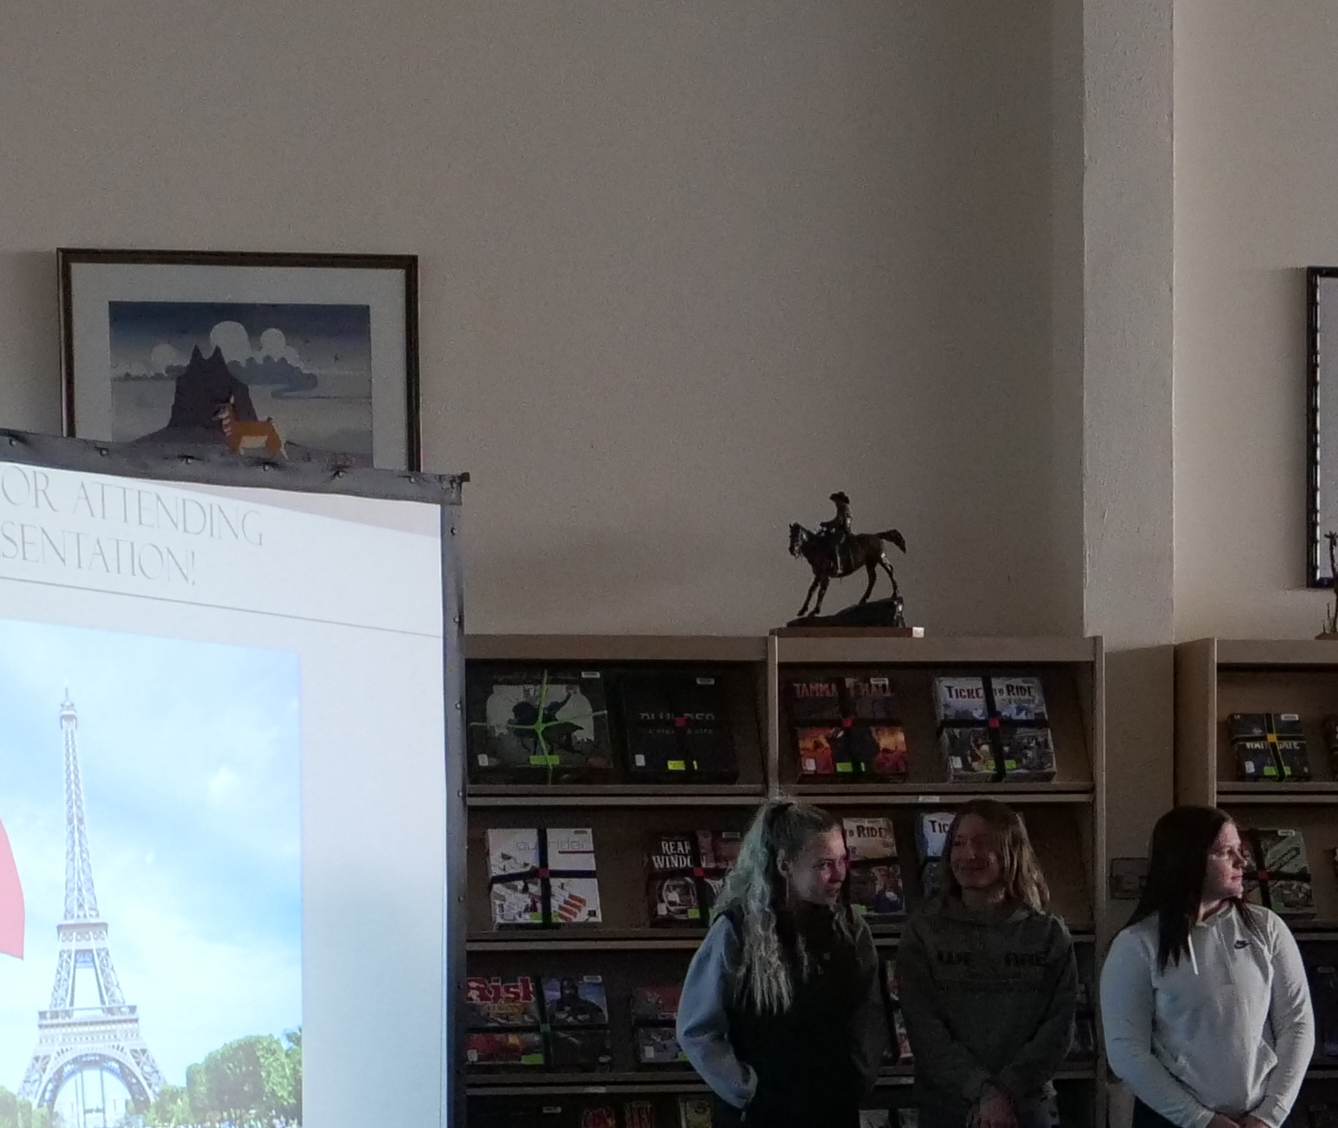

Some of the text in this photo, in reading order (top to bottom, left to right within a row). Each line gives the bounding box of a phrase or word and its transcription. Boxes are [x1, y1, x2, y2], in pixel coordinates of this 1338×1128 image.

[73, 480, 263, 546] ATTENDING
[944, 685, 983, 699] TICKE
[1006, 684, 1034, 698] RIDE
